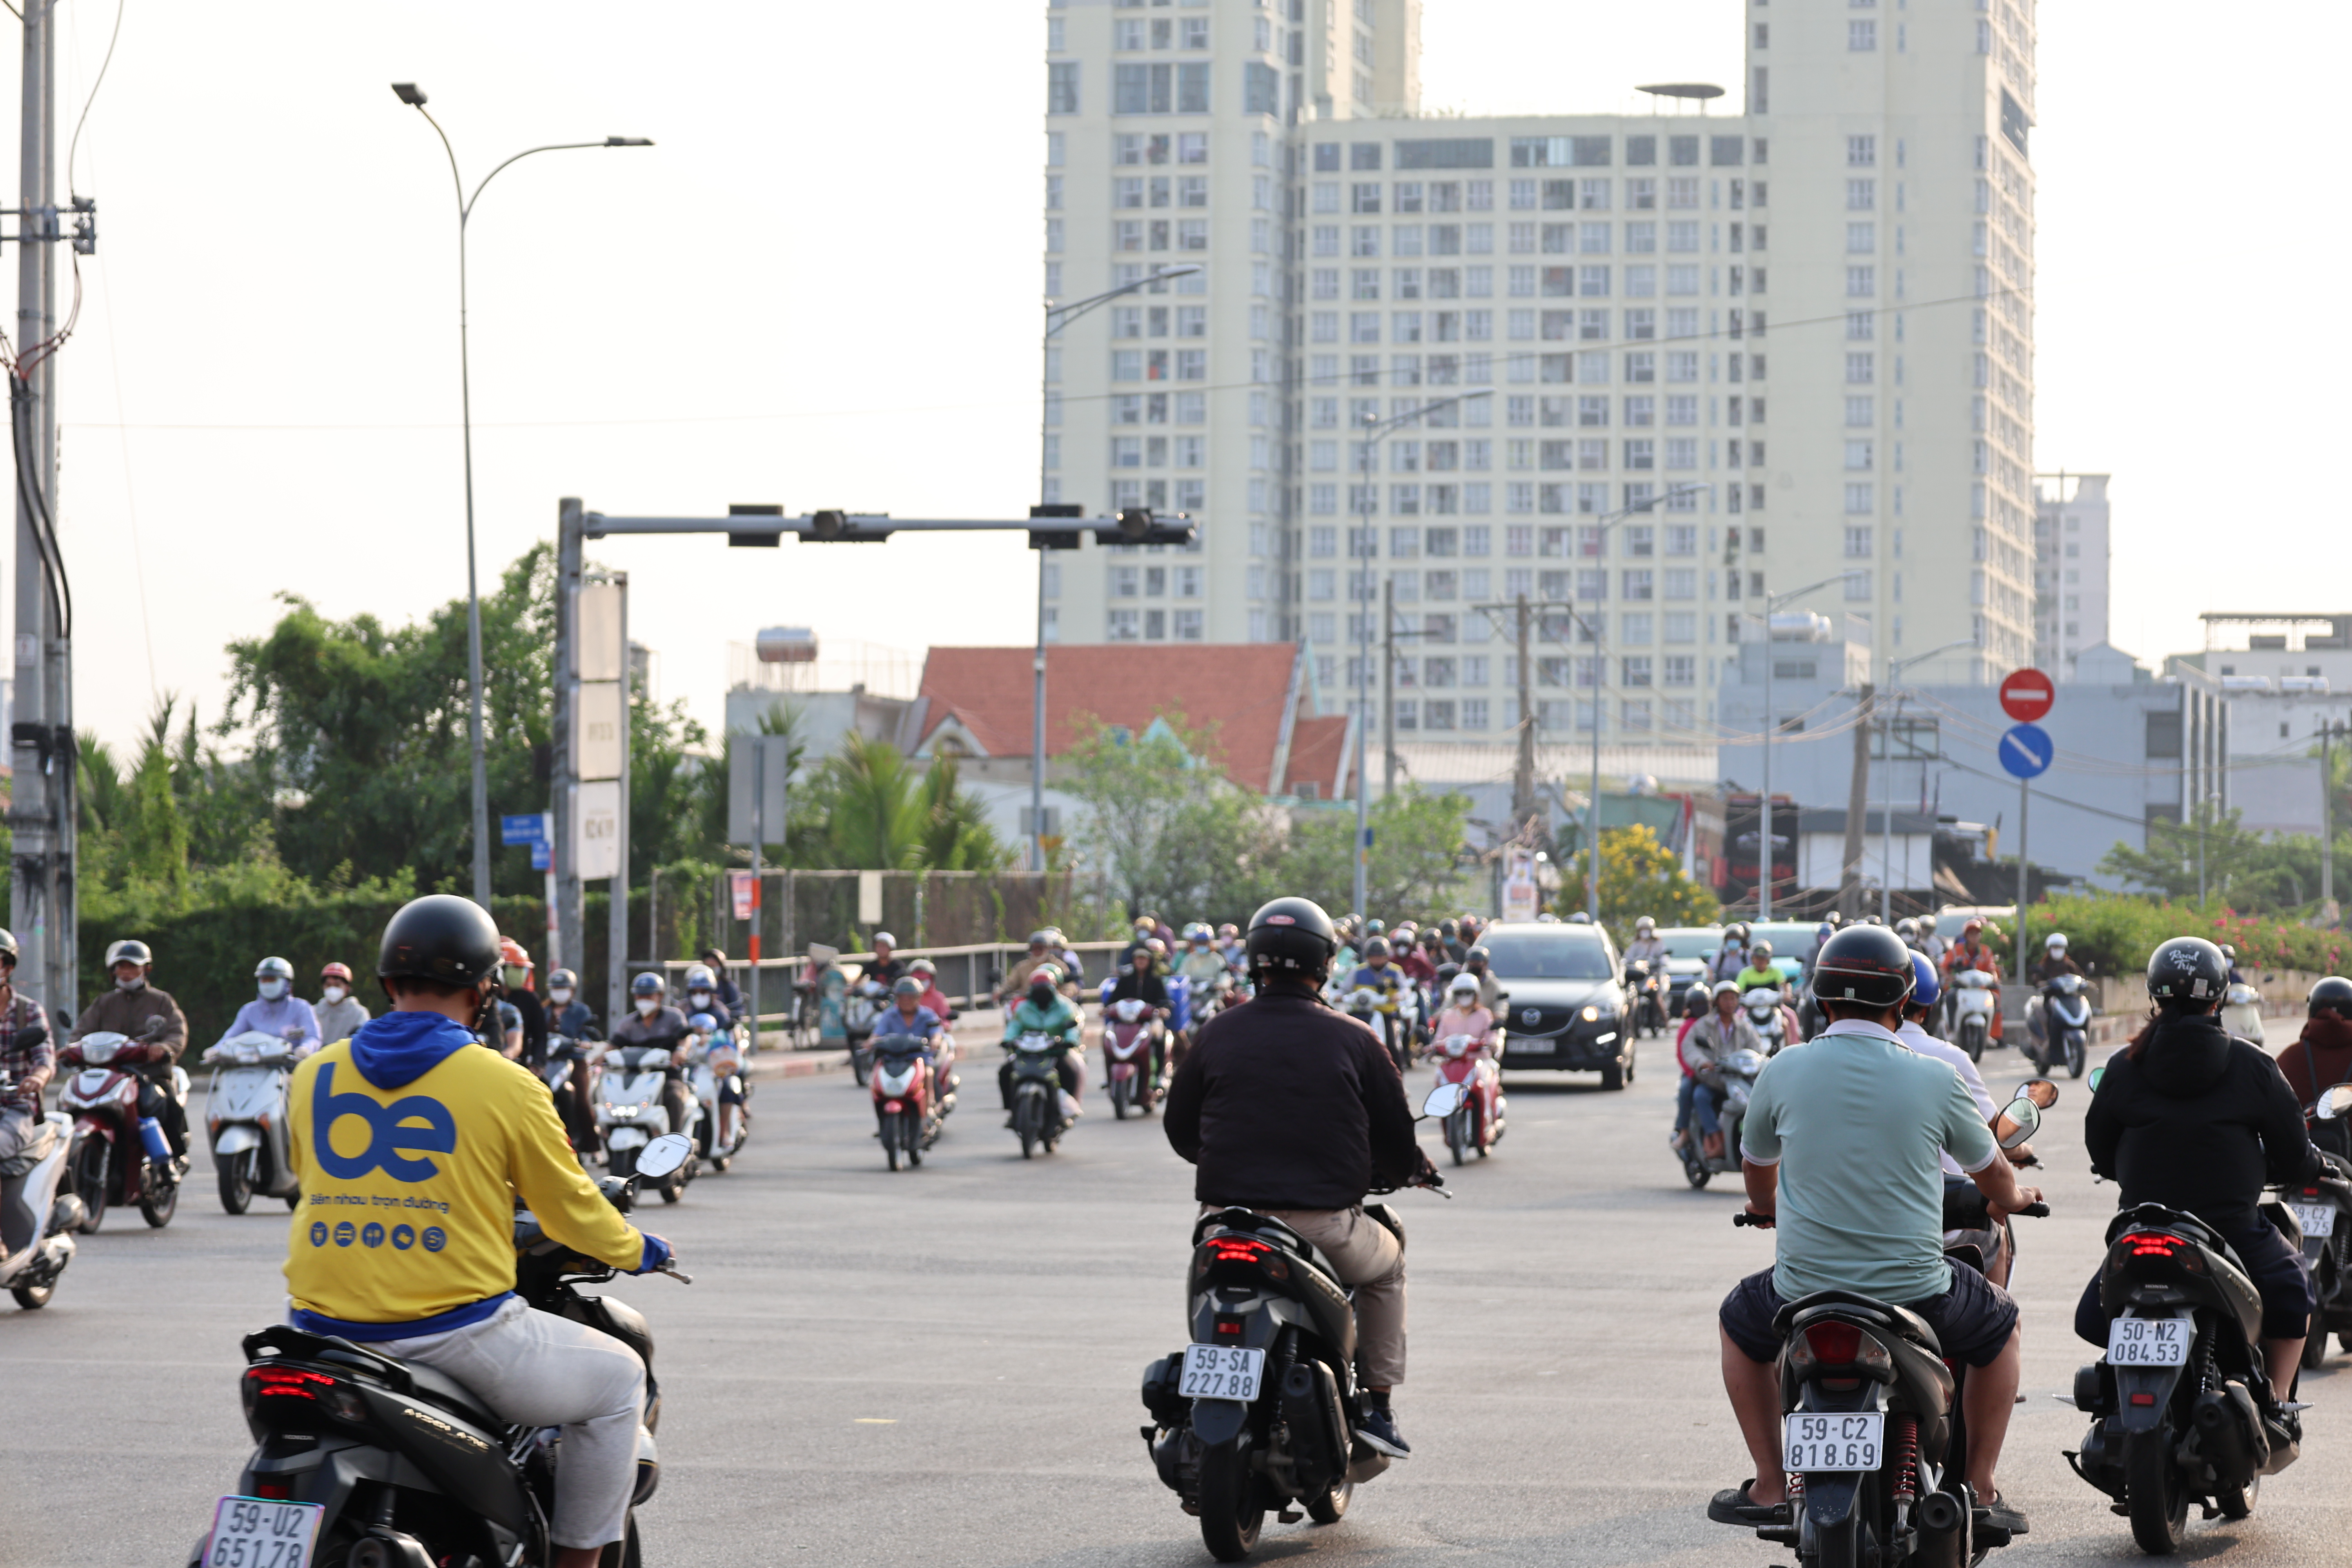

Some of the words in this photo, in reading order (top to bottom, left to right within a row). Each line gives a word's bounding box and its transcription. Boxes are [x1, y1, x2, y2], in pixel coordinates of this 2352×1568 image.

[2169, 949, 2200, 962] Road
[2174, 959, 2196, 976] Trip
[313, 1062, 457, 1182] be
[309, 1193, 332, 1205] Bên
[333, 1193, 368, 1205] nhau
[371, 1194, 400, 1210] trọn
[2302, 1220, 2329, 1234] 9.75
[2123, 1322, 2177, 1341] 50-N2
[1196, 1348, 1250, 1373] 59-SA
[2115, 1343, 2180, 1362] 084.53
[1186, 1372, 1253, 1397] 227.88
[1801, 1417, 1868, 1440] 59-C2
[1791, 1443, 1875, 1467] 818.69
[229, 1503, 305, 1538] 59-U2
[214, 1537, 303, 1568] 651.78
